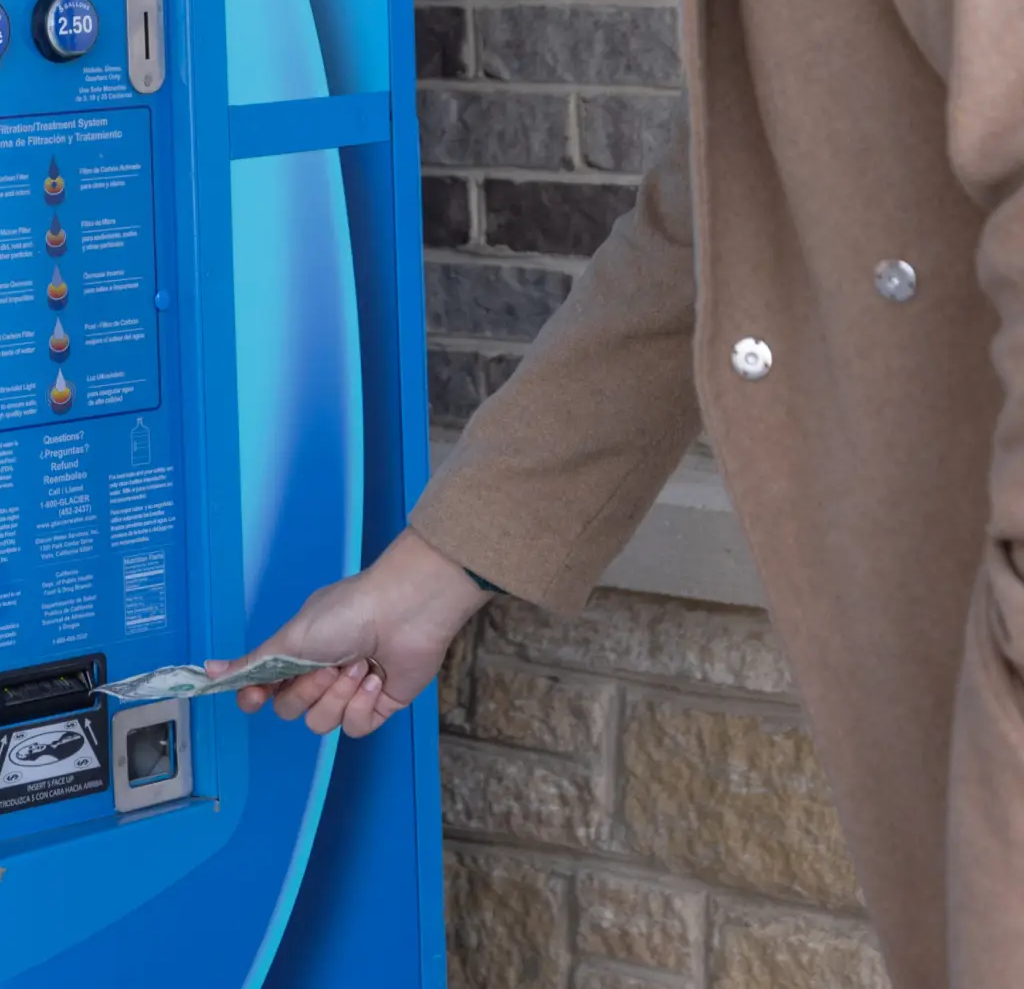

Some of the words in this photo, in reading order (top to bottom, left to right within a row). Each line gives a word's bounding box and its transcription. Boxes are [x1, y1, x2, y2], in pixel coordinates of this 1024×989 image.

[64, 2, 91, 11] GALLONS
[58, 15, 92, 35] 2.50
[78, 117, 108, 130] System
[15, 136, 26, 147] de
[28, 133, 66, 146] Filtración
[68, 134, 73, 145] y
[75, 129, 122, 142] Tratamiento
[43, 430, 85, 445] Questions?
[40, 443, 90, 460] ¿Preguntas?
[50, 458, 79, 472] Refund
[40, 494, 90, 509] 1-800-GLACIER
[27, 781, 46, 792] INSERT
[51, 777, 65, 787] FACE
[65, 775, 75, 784] UP
[36, 792, 48, 801] CON
[65, 784, 83, 794] HACIA
